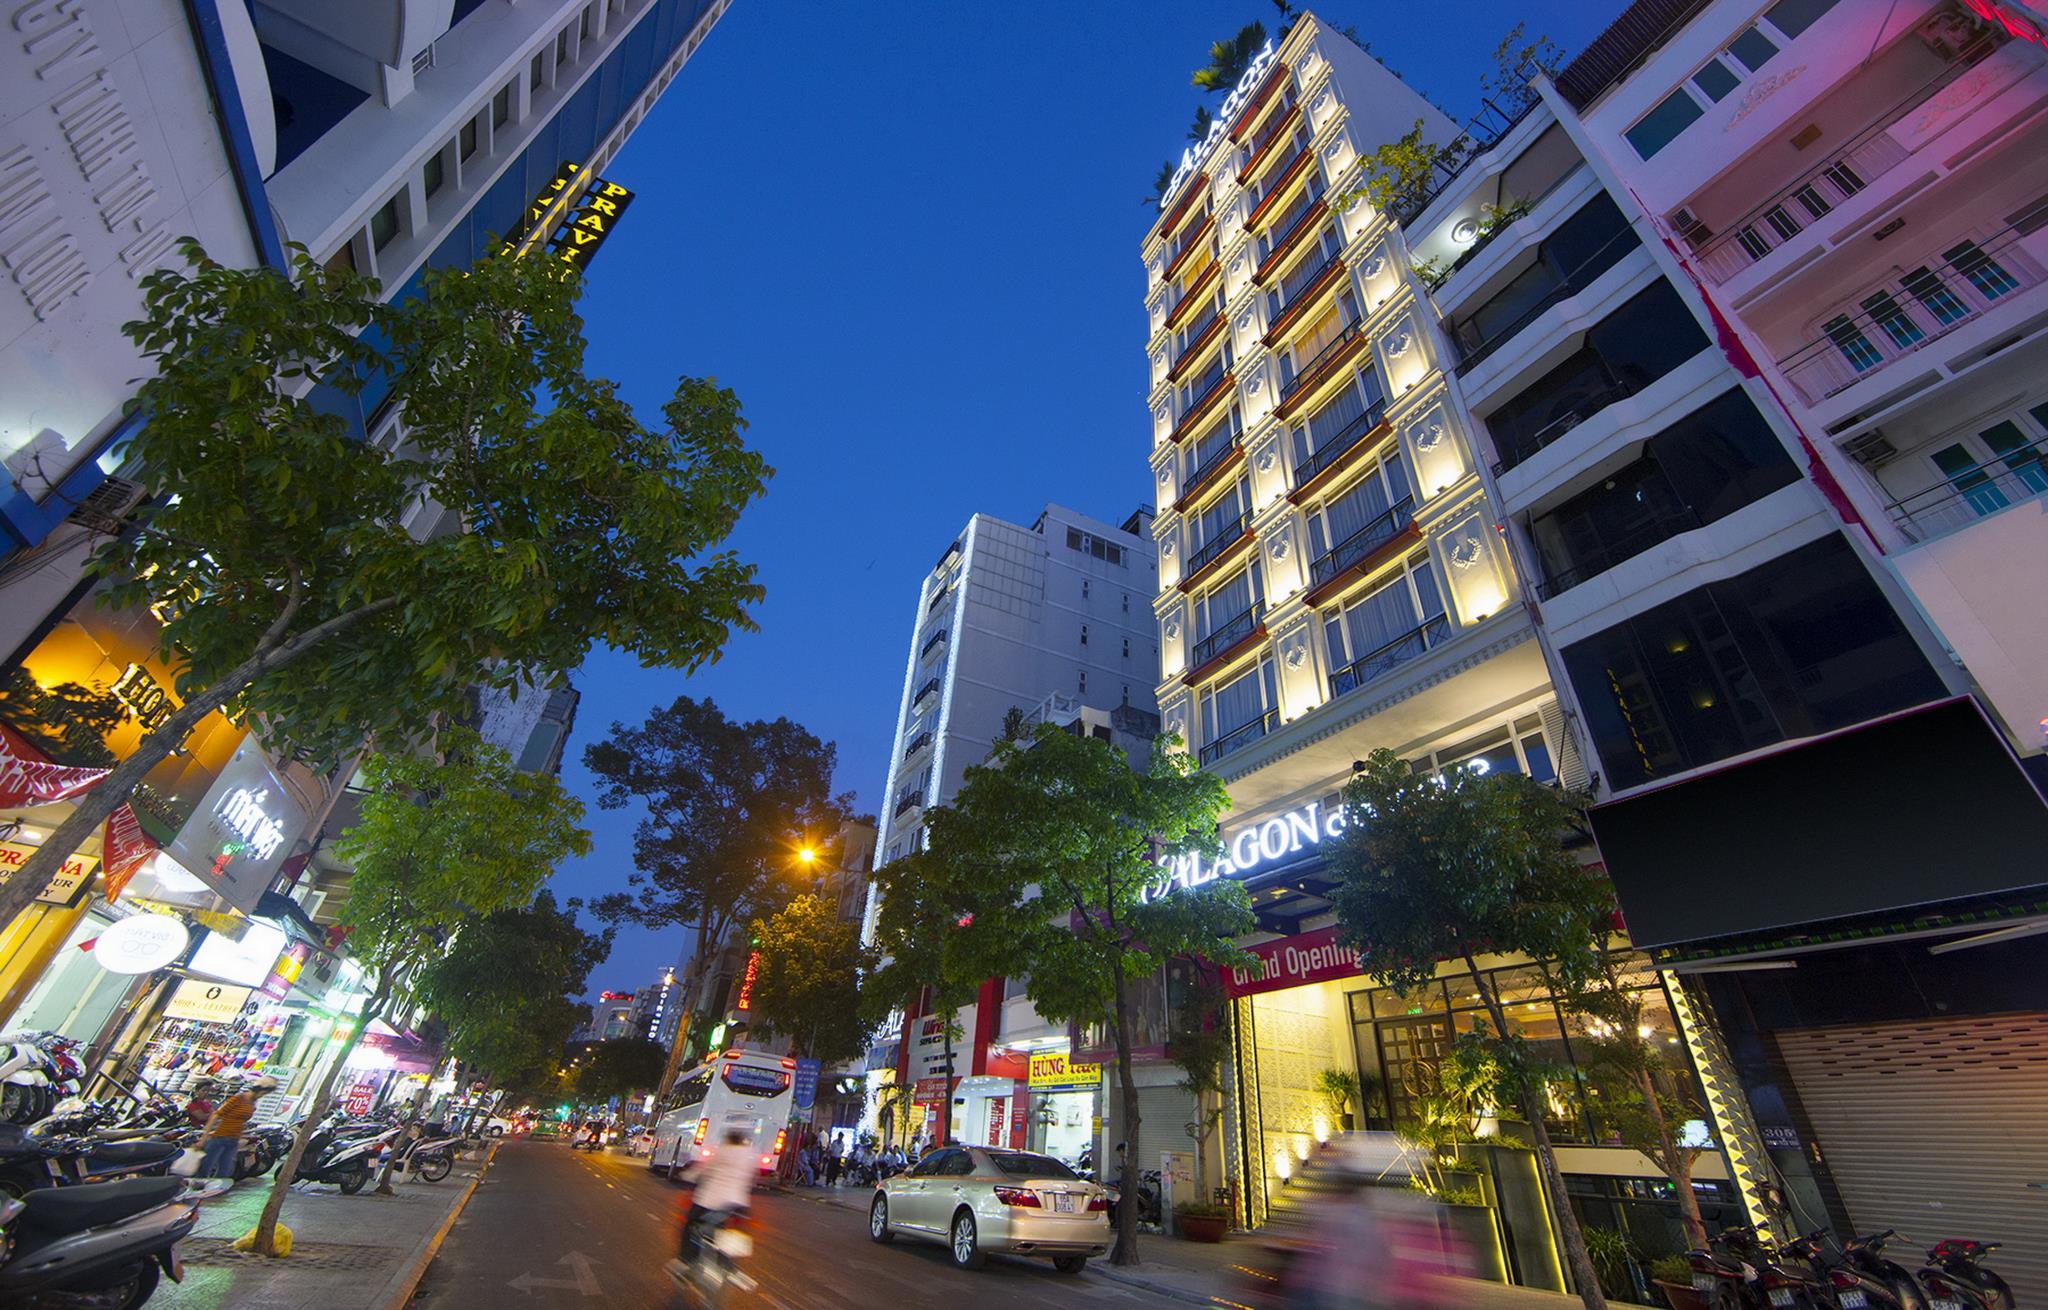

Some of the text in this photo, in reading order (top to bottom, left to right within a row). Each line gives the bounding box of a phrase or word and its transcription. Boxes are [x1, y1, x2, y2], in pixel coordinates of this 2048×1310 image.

[51, 67, 137, 183] TNHH
[1, 216, 94, 322] LONG
[112, 662, 195, 757] HOTL
[353, 1086, 373, 1094] SALE
[1032, 1055, 1065, 1077] HÙNG
